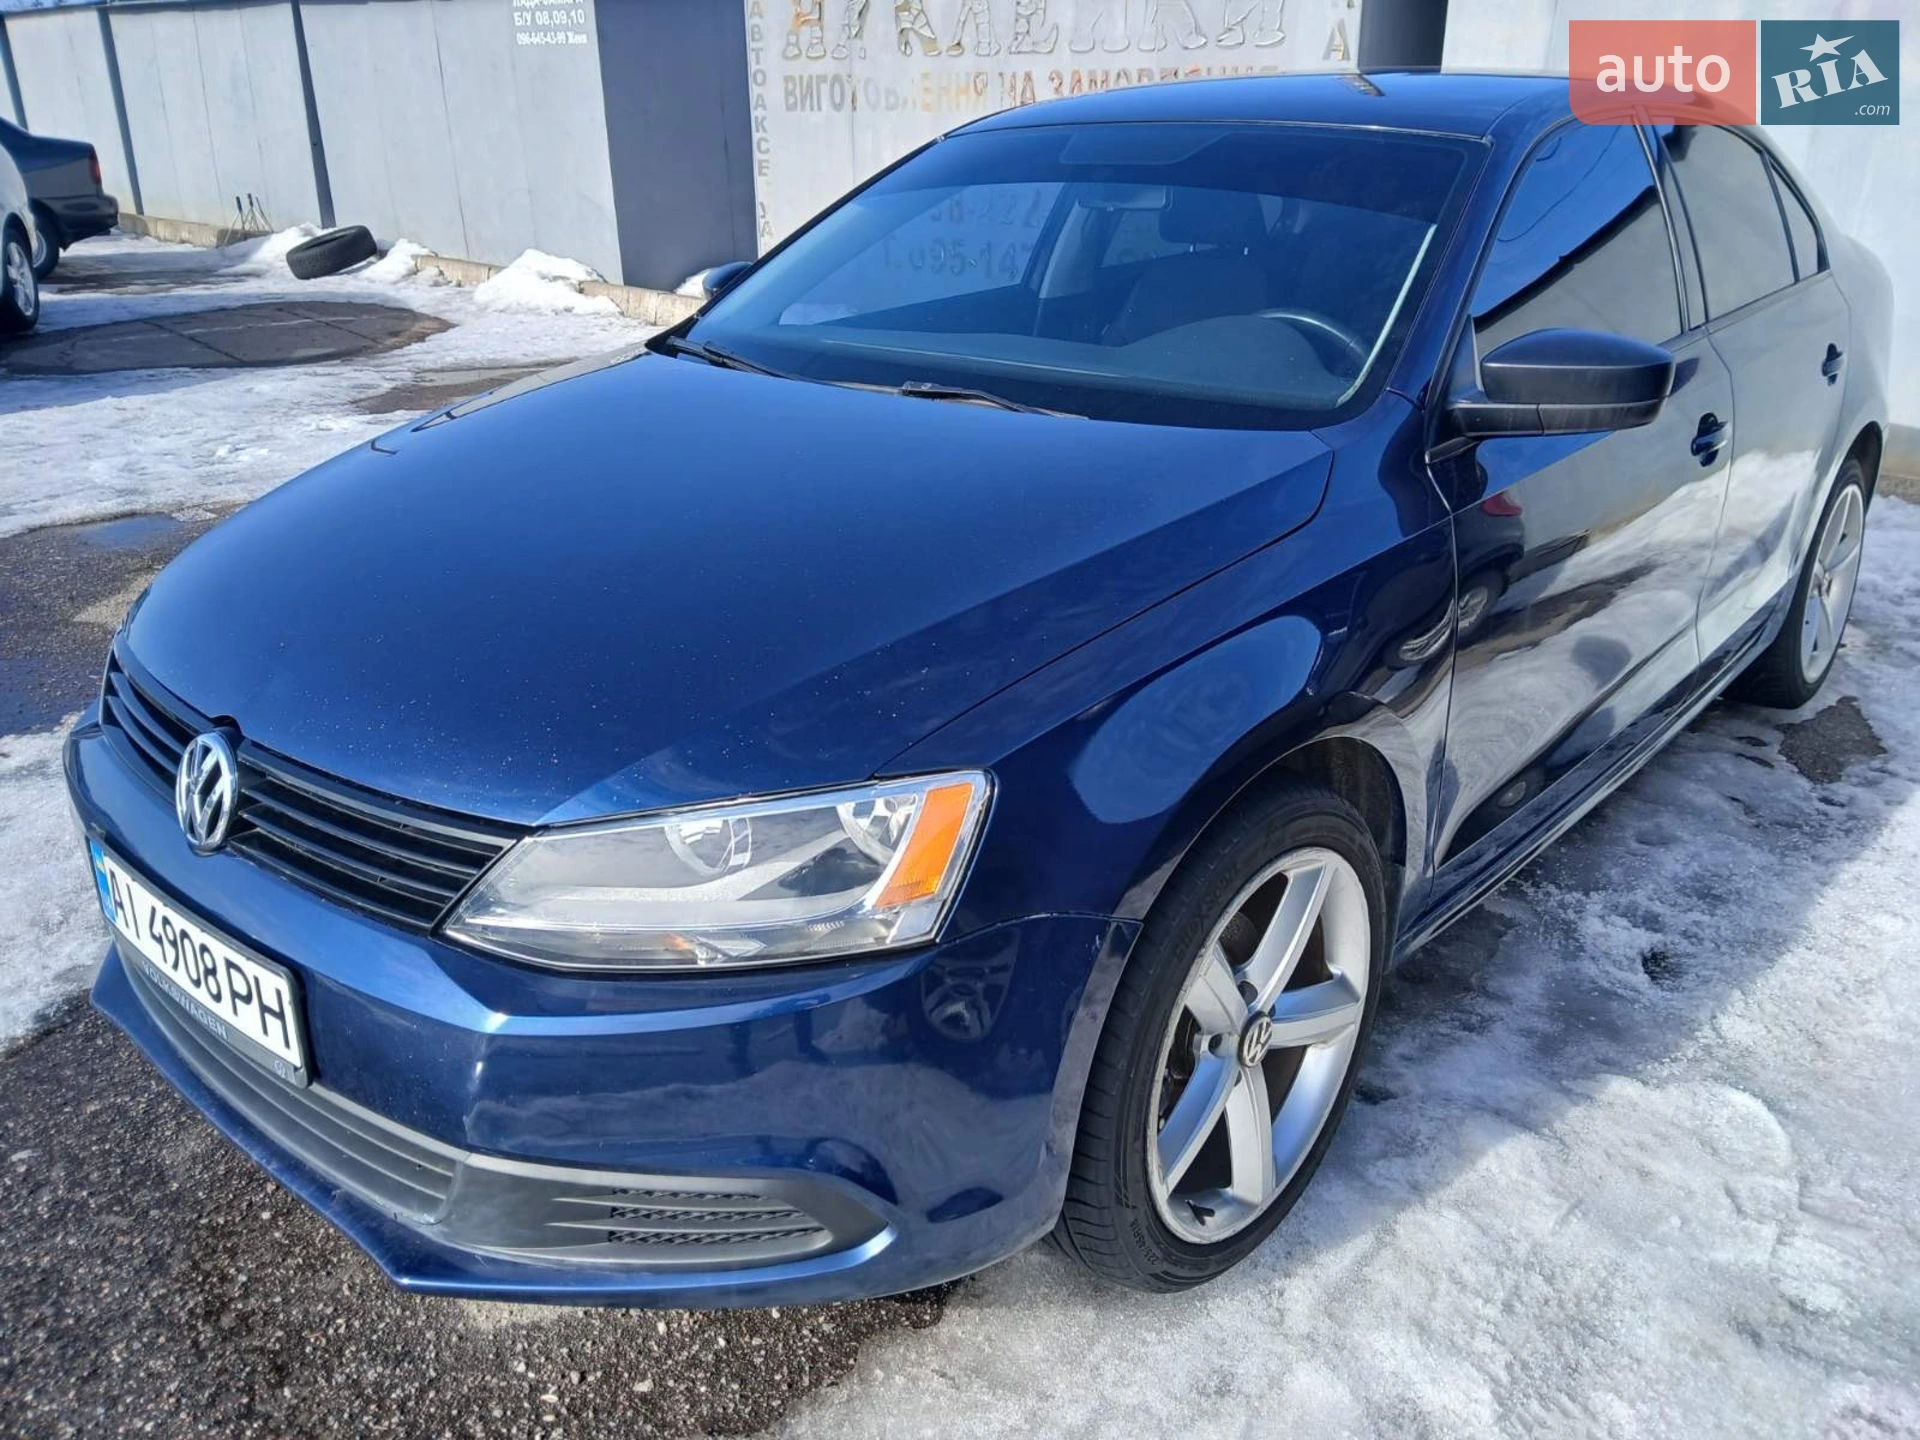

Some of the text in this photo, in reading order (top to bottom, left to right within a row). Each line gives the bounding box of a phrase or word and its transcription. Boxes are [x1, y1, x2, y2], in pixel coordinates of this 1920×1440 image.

[513, 9, 585, 29] Б/У 08,09,10
[108, 867, 291, 1050] AI 4908 PH
[141, 959, 229, 1041] VOLKSWAGEN
